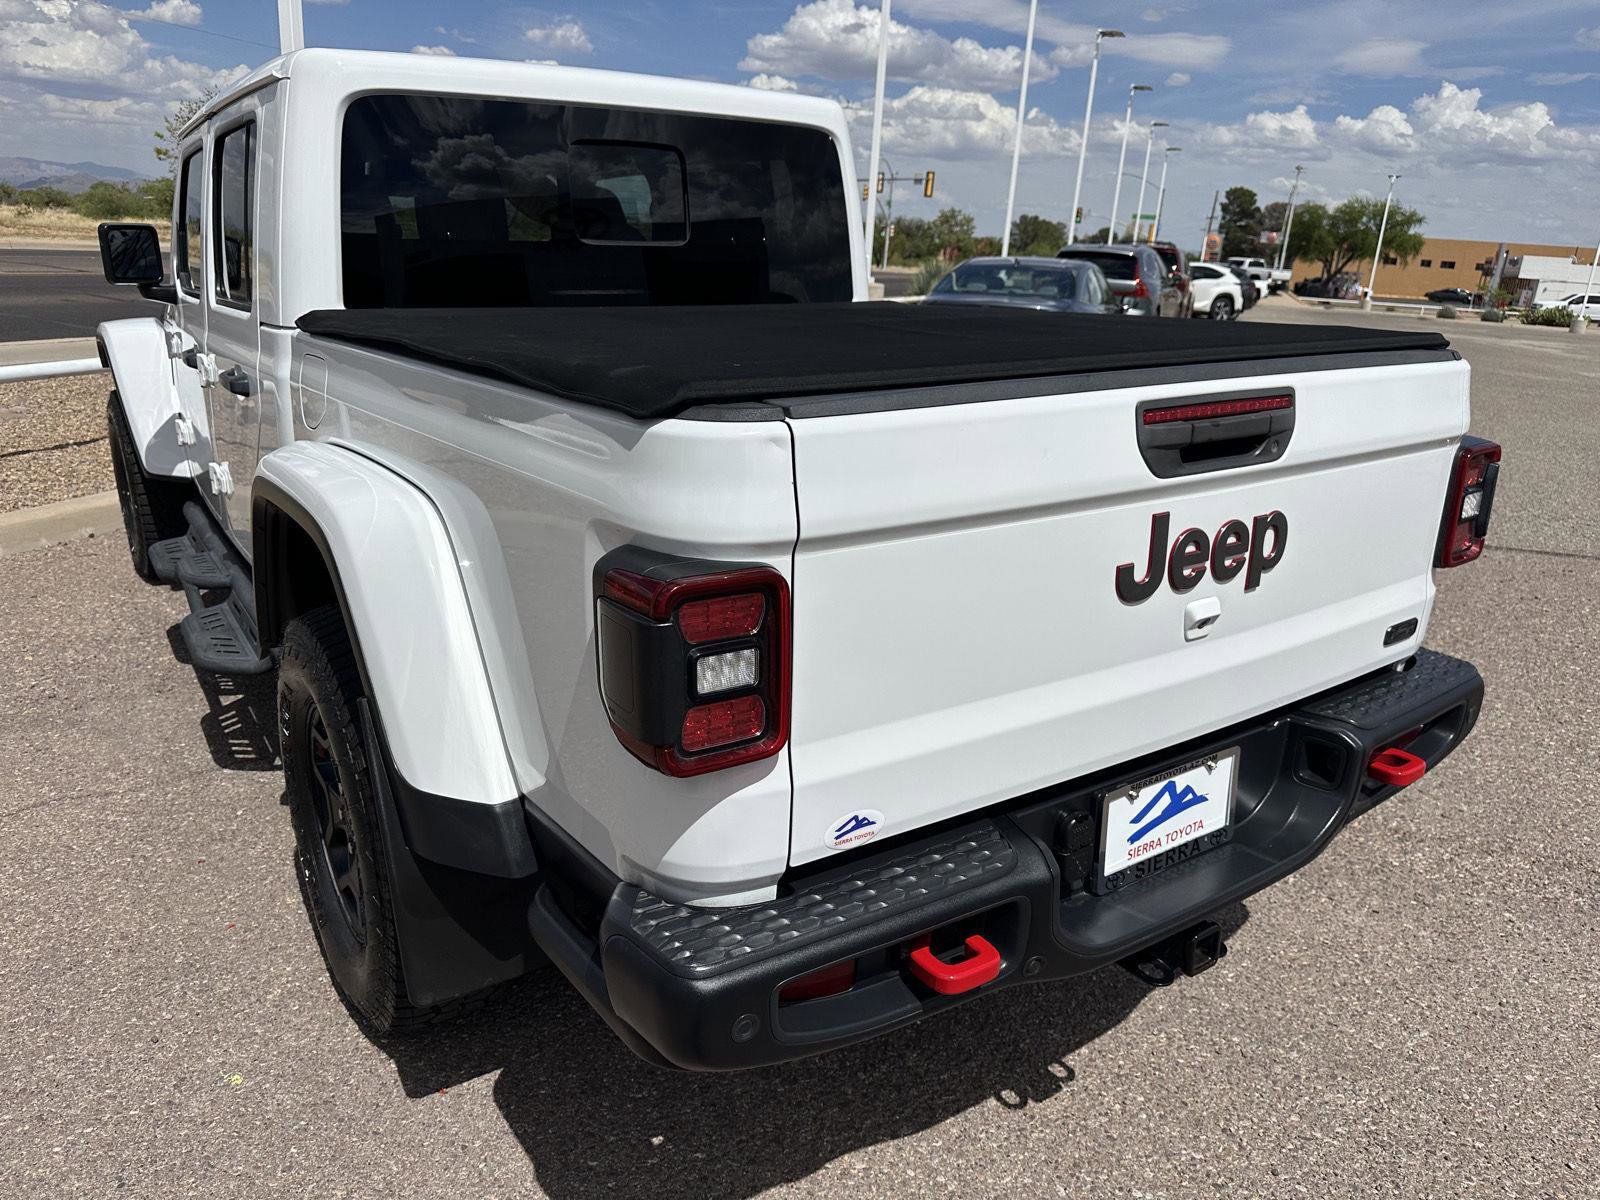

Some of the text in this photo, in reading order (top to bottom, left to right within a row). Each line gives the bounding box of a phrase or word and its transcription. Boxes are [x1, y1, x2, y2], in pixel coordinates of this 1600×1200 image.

[1115, 510, 1289, 605] Jeep
[834, 831, 875, 846] SIERRA TOYOTA
[1127, 819, 1204, 860] SIERRA TOYOTA
[1135, 838, 1200, 878] SIERRA
